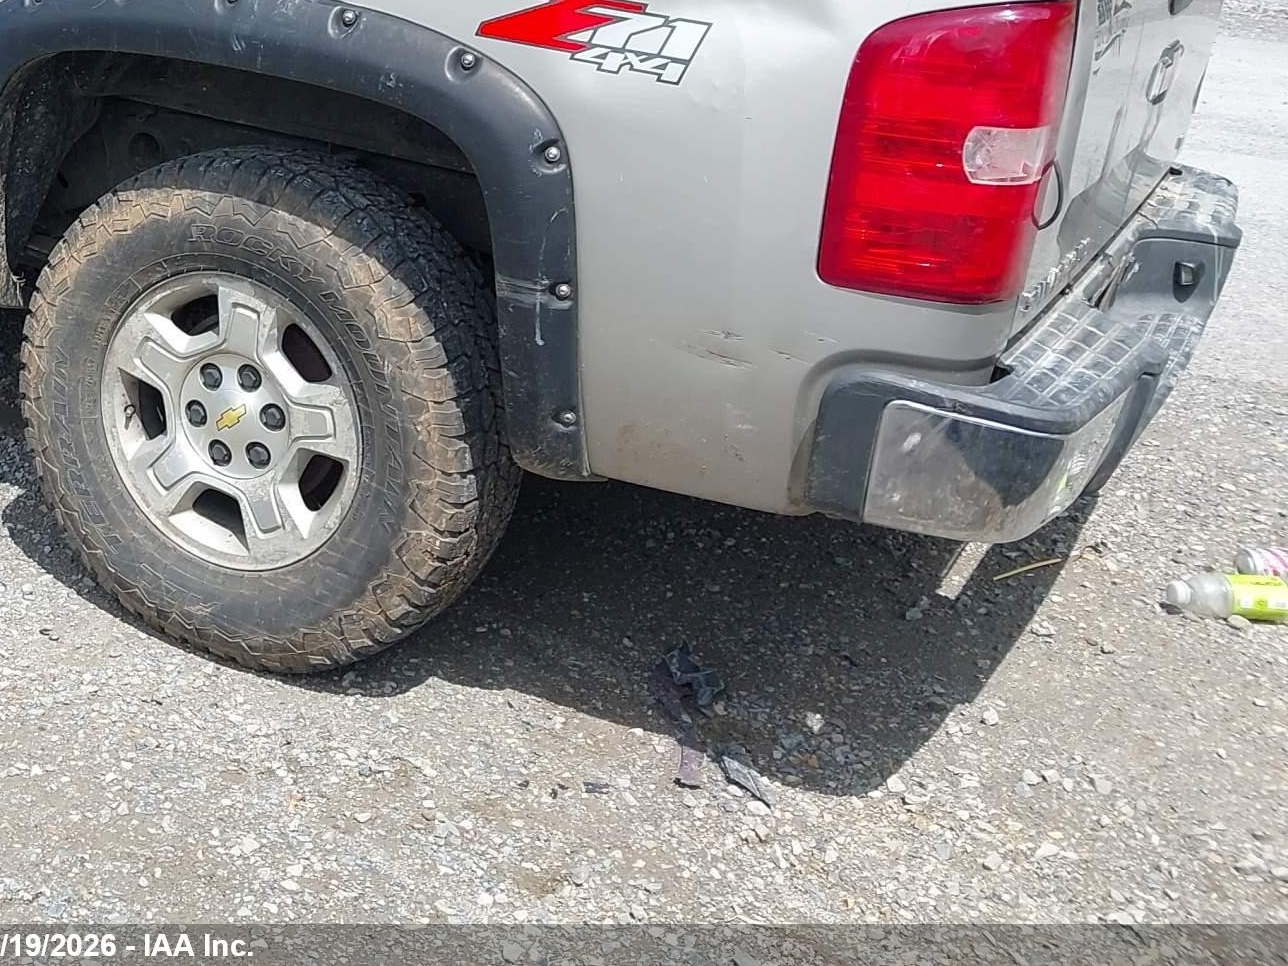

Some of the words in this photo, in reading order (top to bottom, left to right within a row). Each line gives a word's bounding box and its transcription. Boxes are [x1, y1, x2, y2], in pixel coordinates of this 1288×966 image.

[52, 345, 123, 555] TERRAIN
[188, 223, 326, 284] ROCKY
[319, 290, 403, 532] MOUNTAIN
